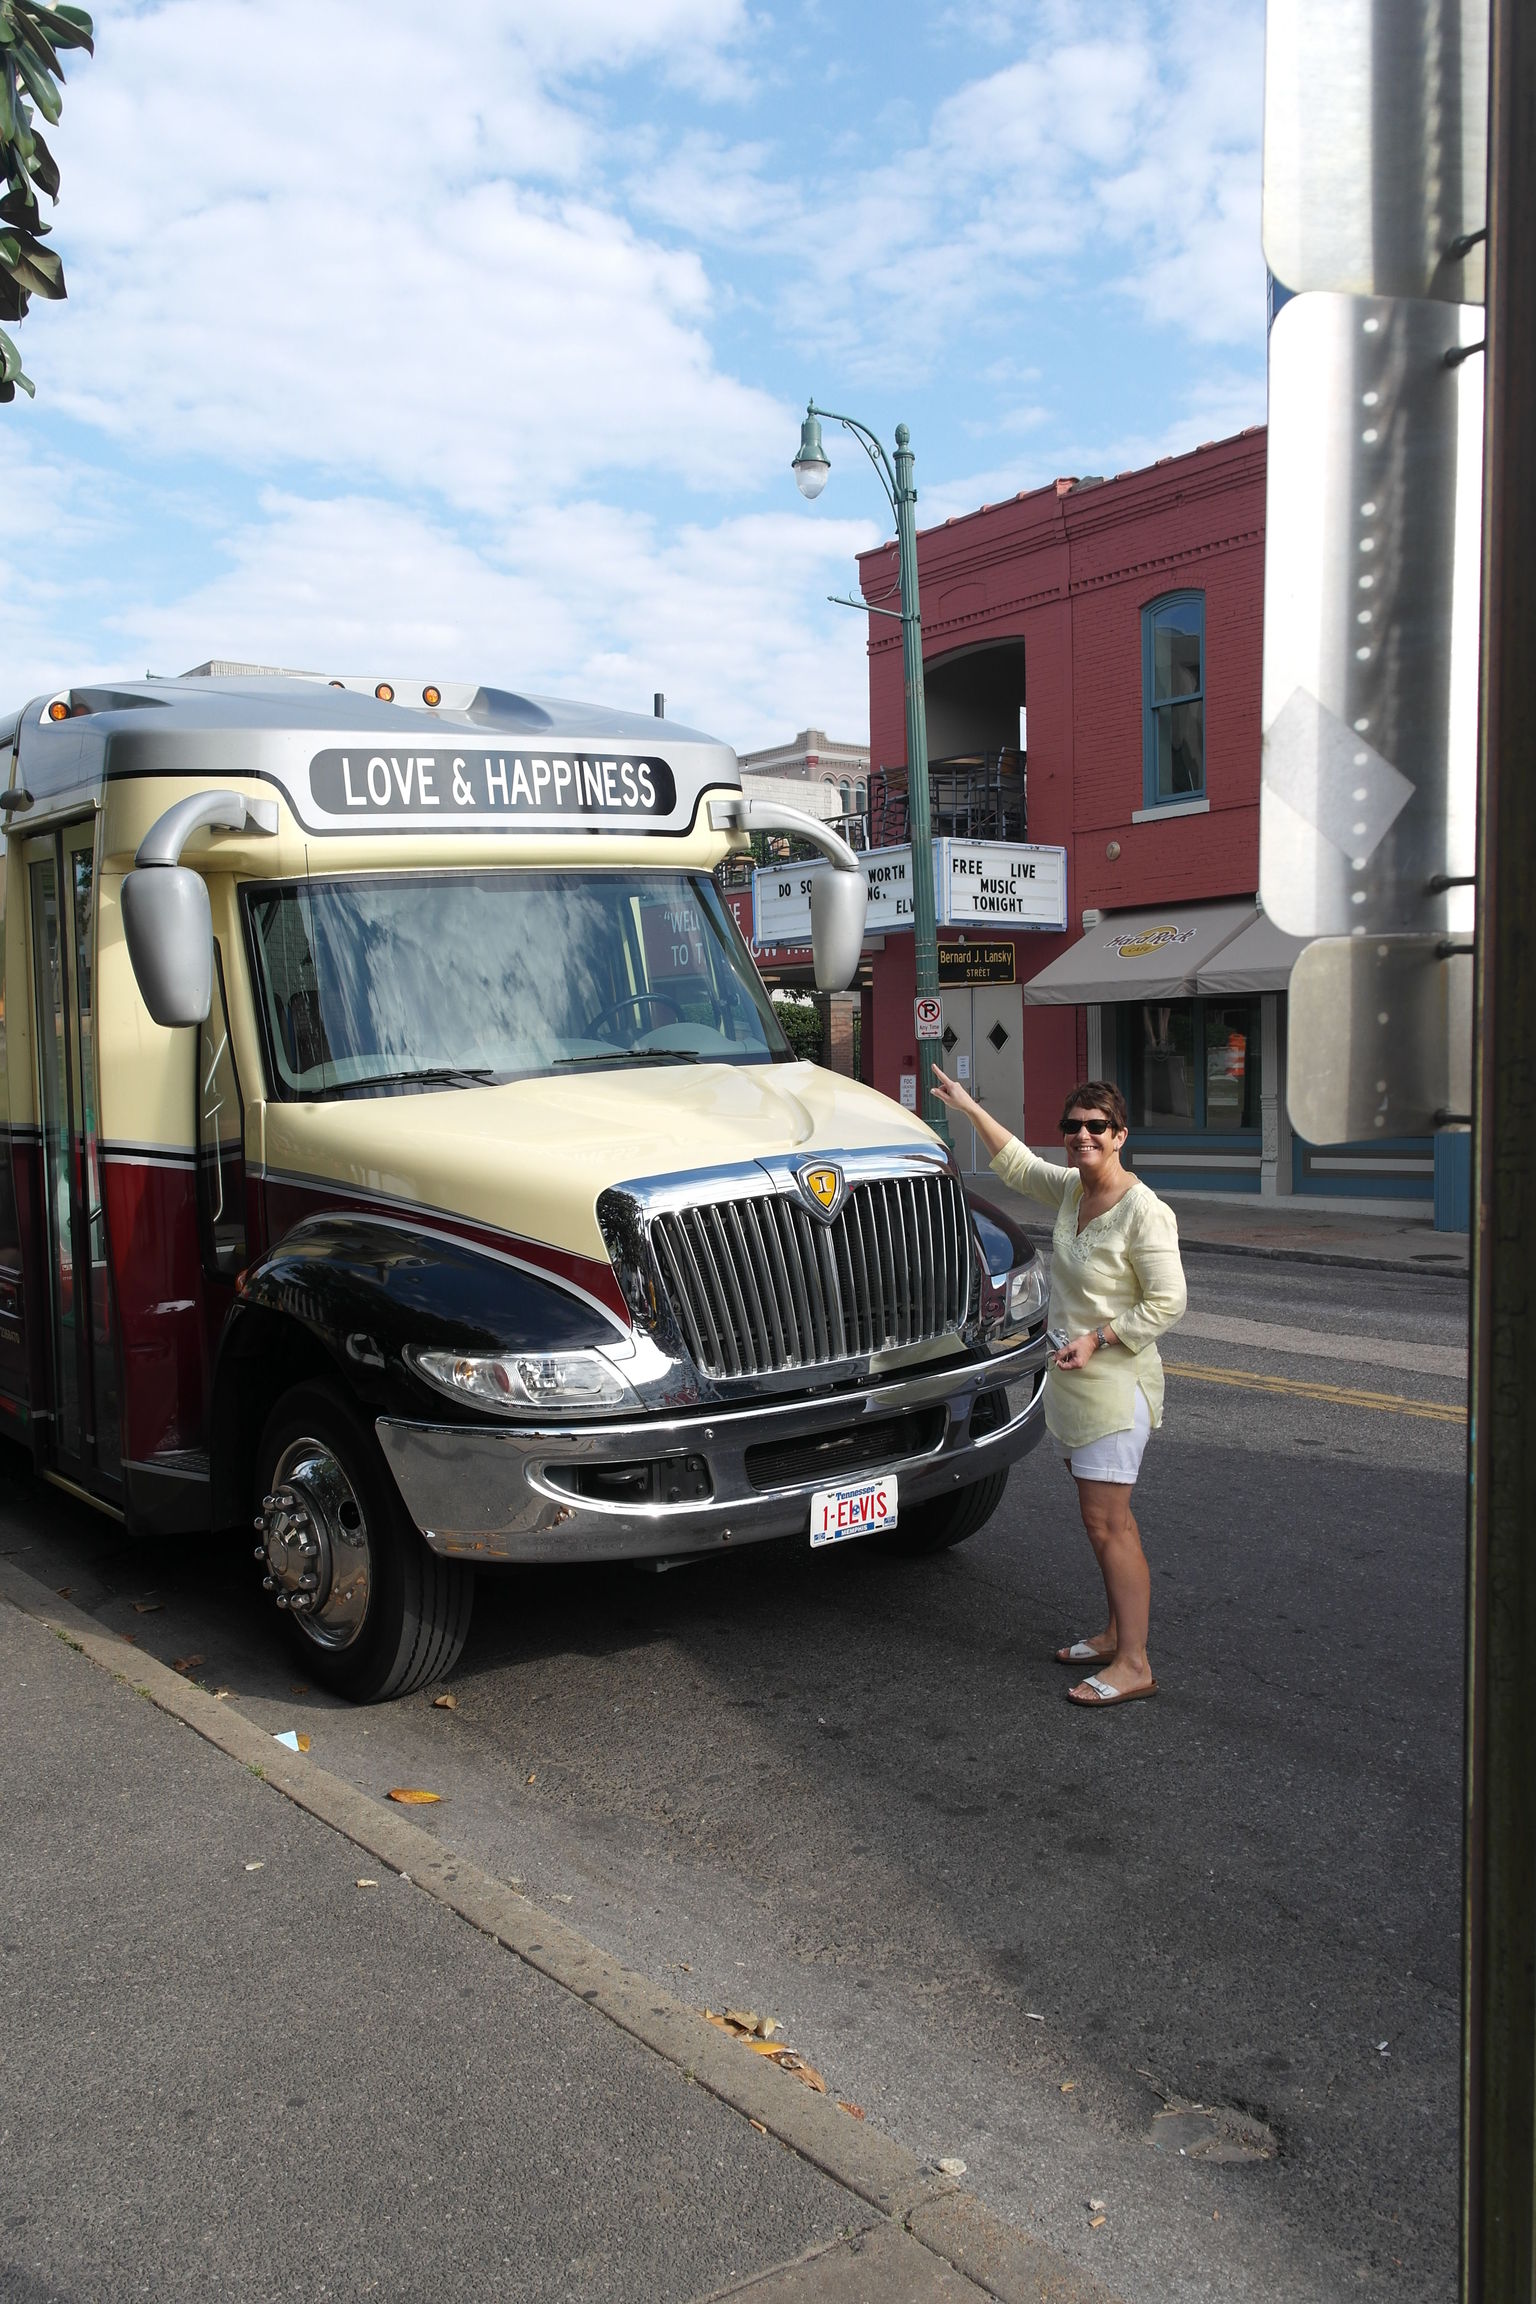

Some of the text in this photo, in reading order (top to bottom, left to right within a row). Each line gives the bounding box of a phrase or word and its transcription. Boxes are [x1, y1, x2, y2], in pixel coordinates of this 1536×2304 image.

[342, 757, 656, 808] LOVE & HAPPINESS
[952, 859, 1036, 878] FREE LIVE
[778, 883, 791, 897] DO
[868, 865, 905, 883] WORTH
[980, 878, 1017, 894] MUSIC
[896, 898, 914, 914] ELV
[972, 896, 1023, 912] TONIGHT
[1150, 928, 1197, 946] Rock
[671, 943, 689, 967] TO
[940, 950, 1012, 966] Bernard J. Lansky
[966, 968, 991, 977] STREET
[835, 1485, 876, 1501] Tennessee
[823, 1491, 888, 1532] 1-ELVIS
[841, 1524, 868, 1536] MEMPHIS
